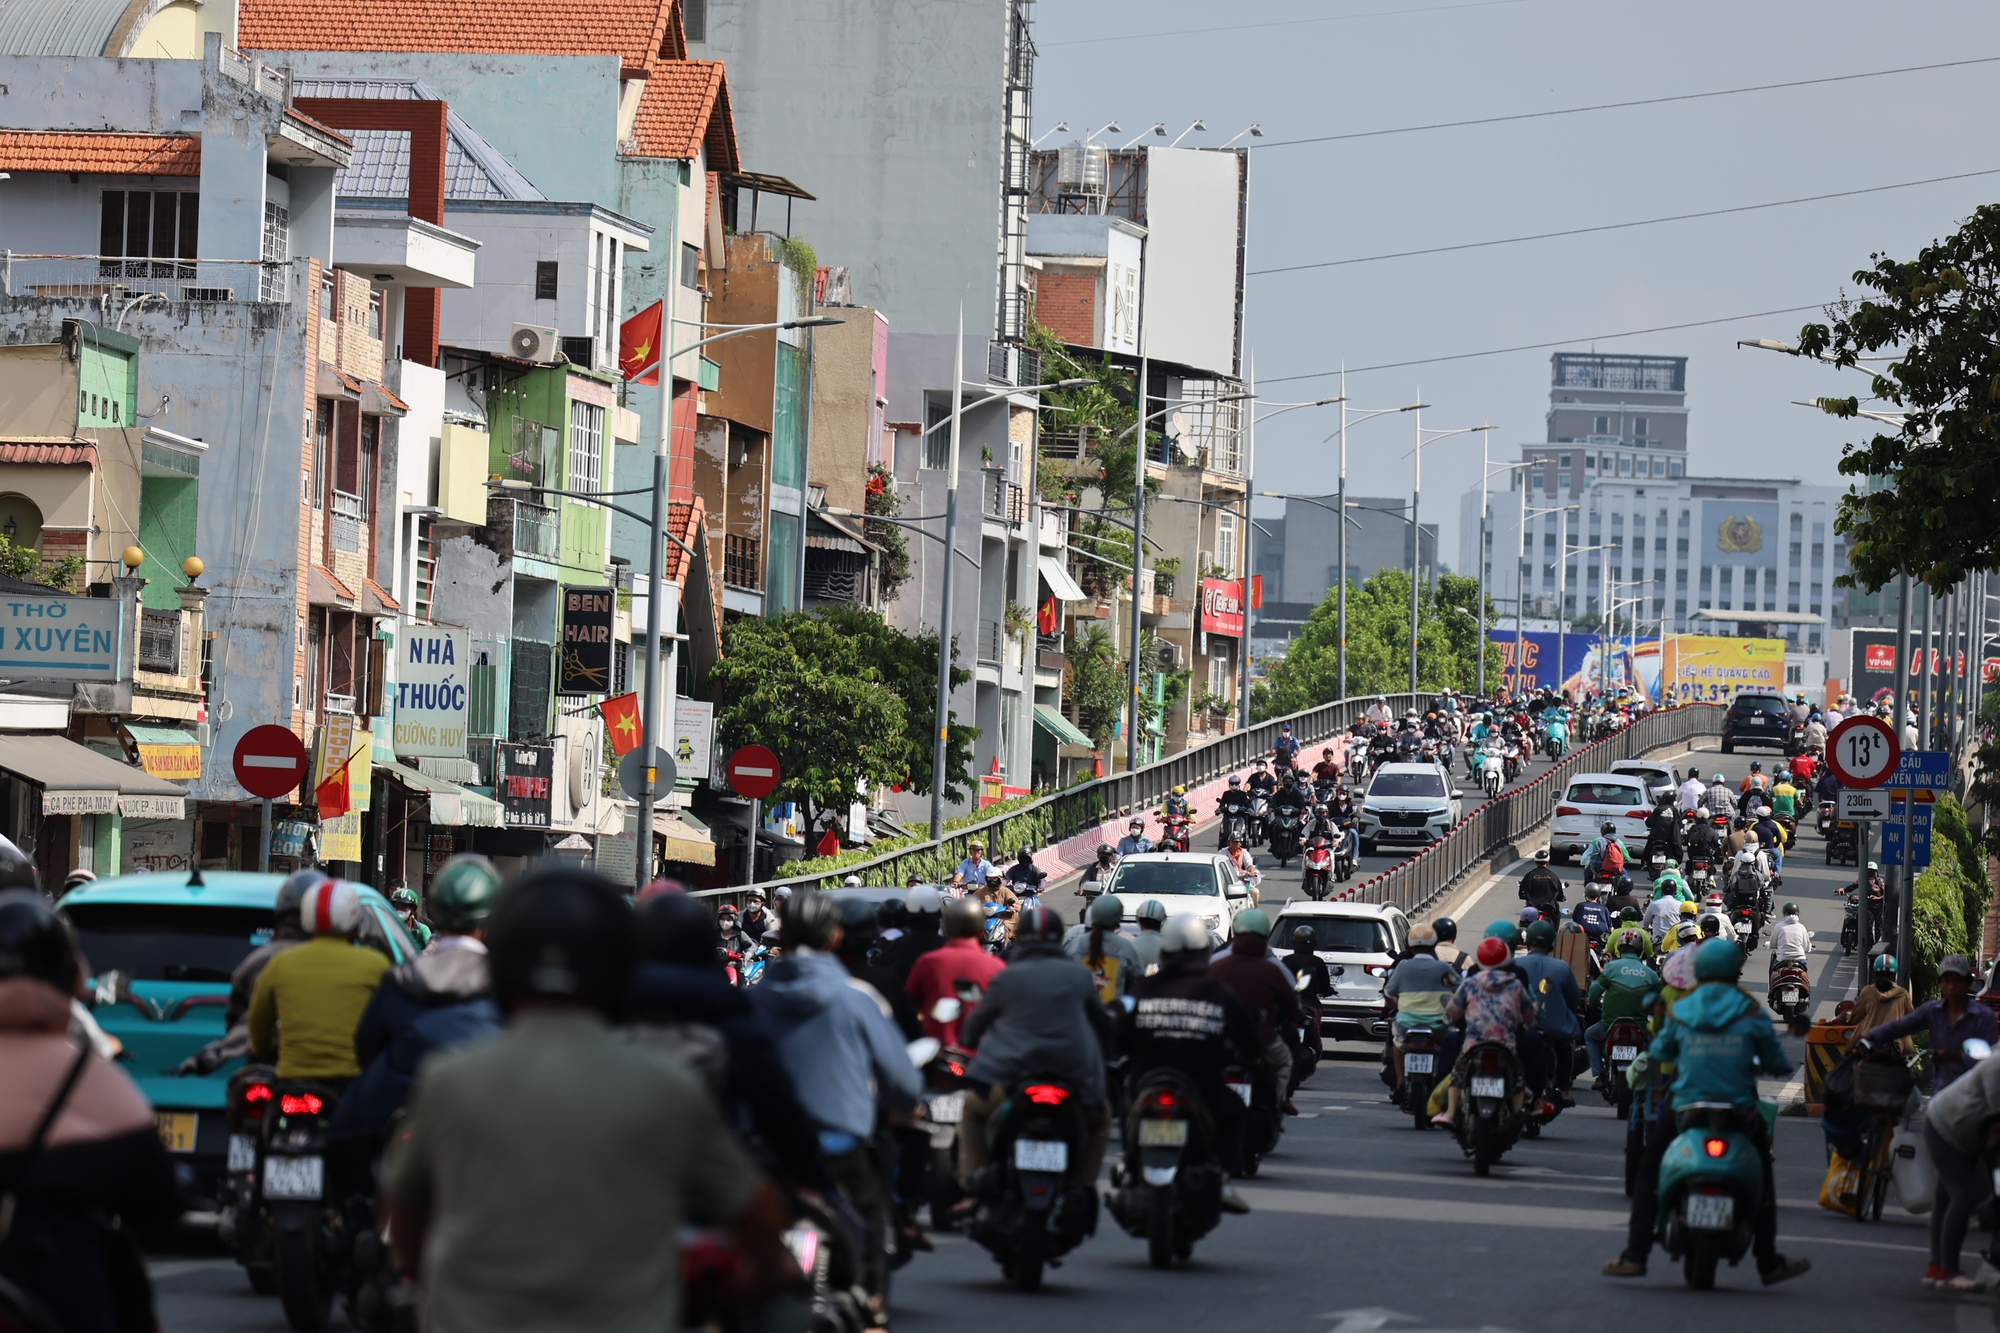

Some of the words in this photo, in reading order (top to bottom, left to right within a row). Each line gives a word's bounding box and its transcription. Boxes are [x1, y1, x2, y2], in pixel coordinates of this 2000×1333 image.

[7, 600, 67, 618] THỜ
[568, 593, 609, 612] BEN
[14, 622, 111, 653] XUYÊN
[564, 624, 609, 643] HAIR
[409, 633, 455, 665] NHÀ
[1868, 658, 1892, 667] VIFON
[1701, 664, 1714, 680] HỆ
[1716, 664, 1749, 679] QUẢNG
[398, 673, 465, 711] THUỐC
[394, 719, 437, 747] CƯỜNG
[439, 727, 464, 748] HUY
[1900, 752, 1922, 769] CẦU
[1885, 768, 1912, 785] UYỄN
[1914, 771, 1932, 785] VĂN
[1935, 771, 1948, 786] CỪ
[50, 794, 61, 811] CÀ
[78, 796, 92, 810] PHA
[95, 793, 113, 810] MÁY
[1846, 795, 1872, 807] 230m
[1912, 815, 1928, 826] CAO
[1888, 832, 1899, 843] AN
[1620, 966, 1647, 978] Grab
[1408, 1063, 1429, 1072] 4812
